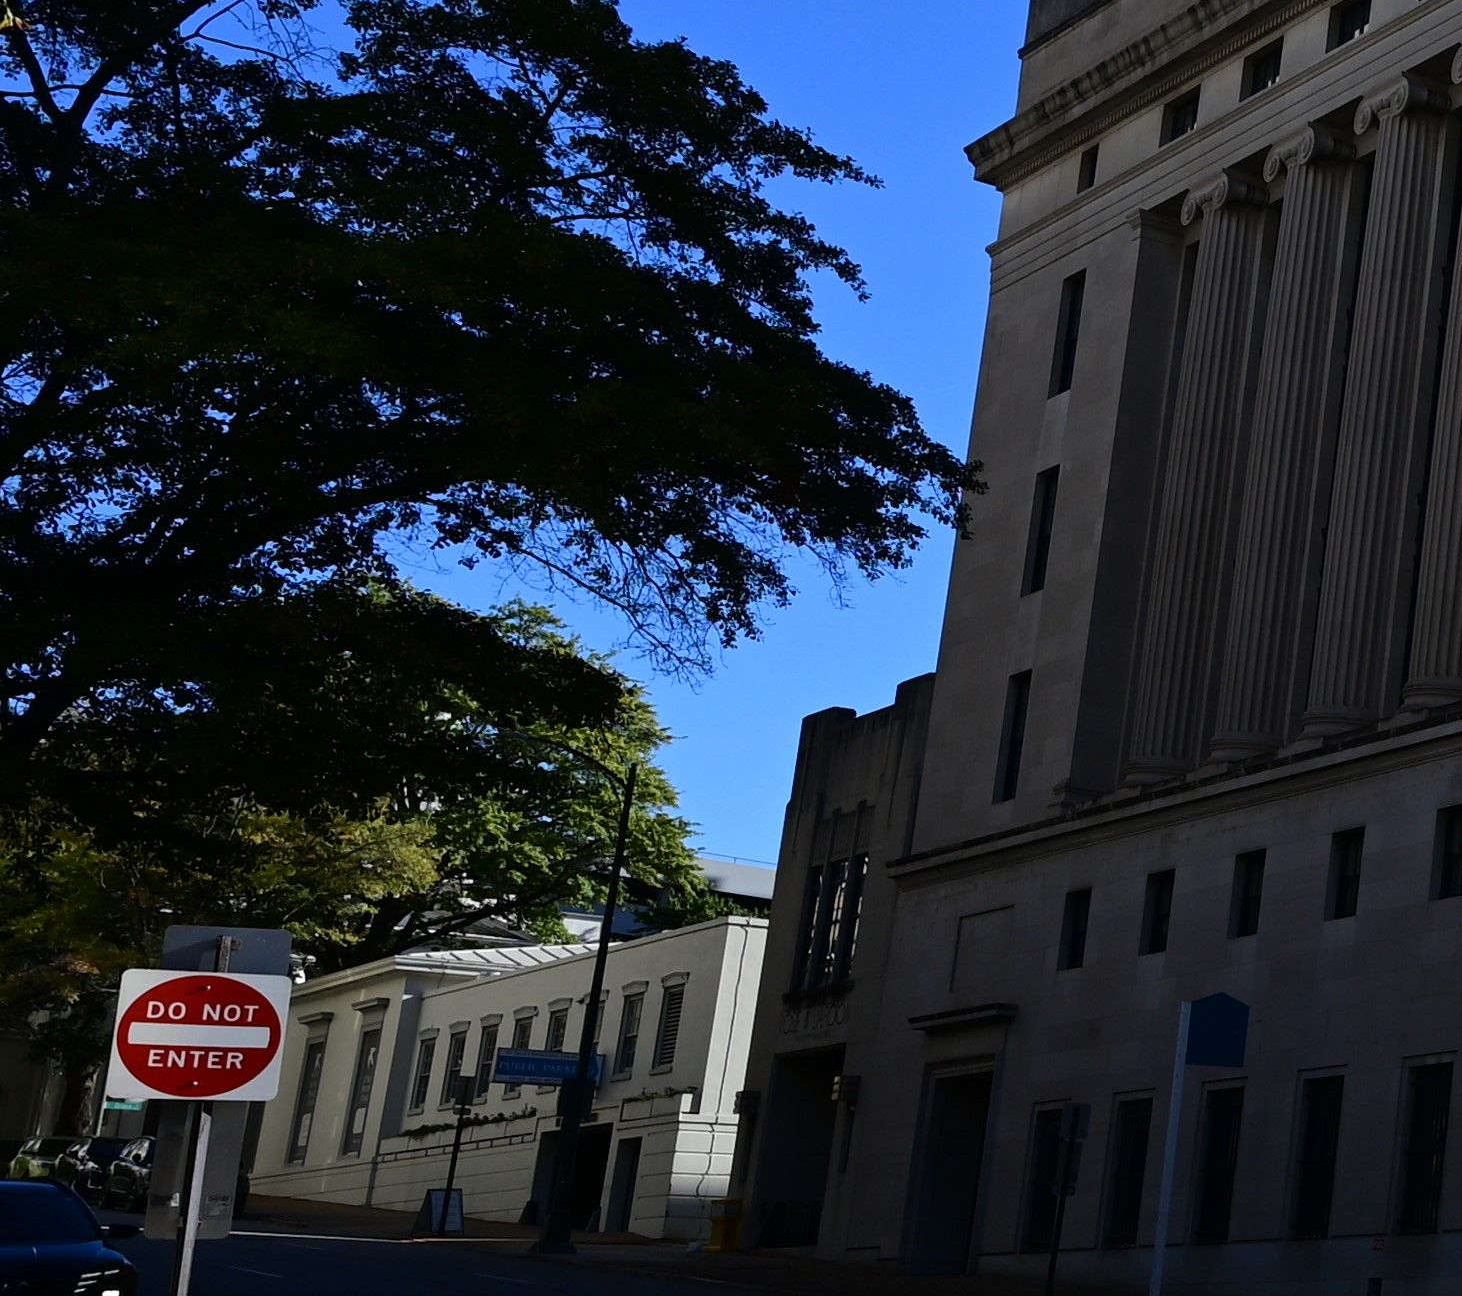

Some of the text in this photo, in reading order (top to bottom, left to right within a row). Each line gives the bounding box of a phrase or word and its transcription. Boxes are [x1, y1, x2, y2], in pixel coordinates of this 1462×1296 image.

[146, 1000, 259, 1022] DO NOT
[147, 1049, 244, 1069] ENTER
[499, 1061, 539, 1072] PUBLIC
